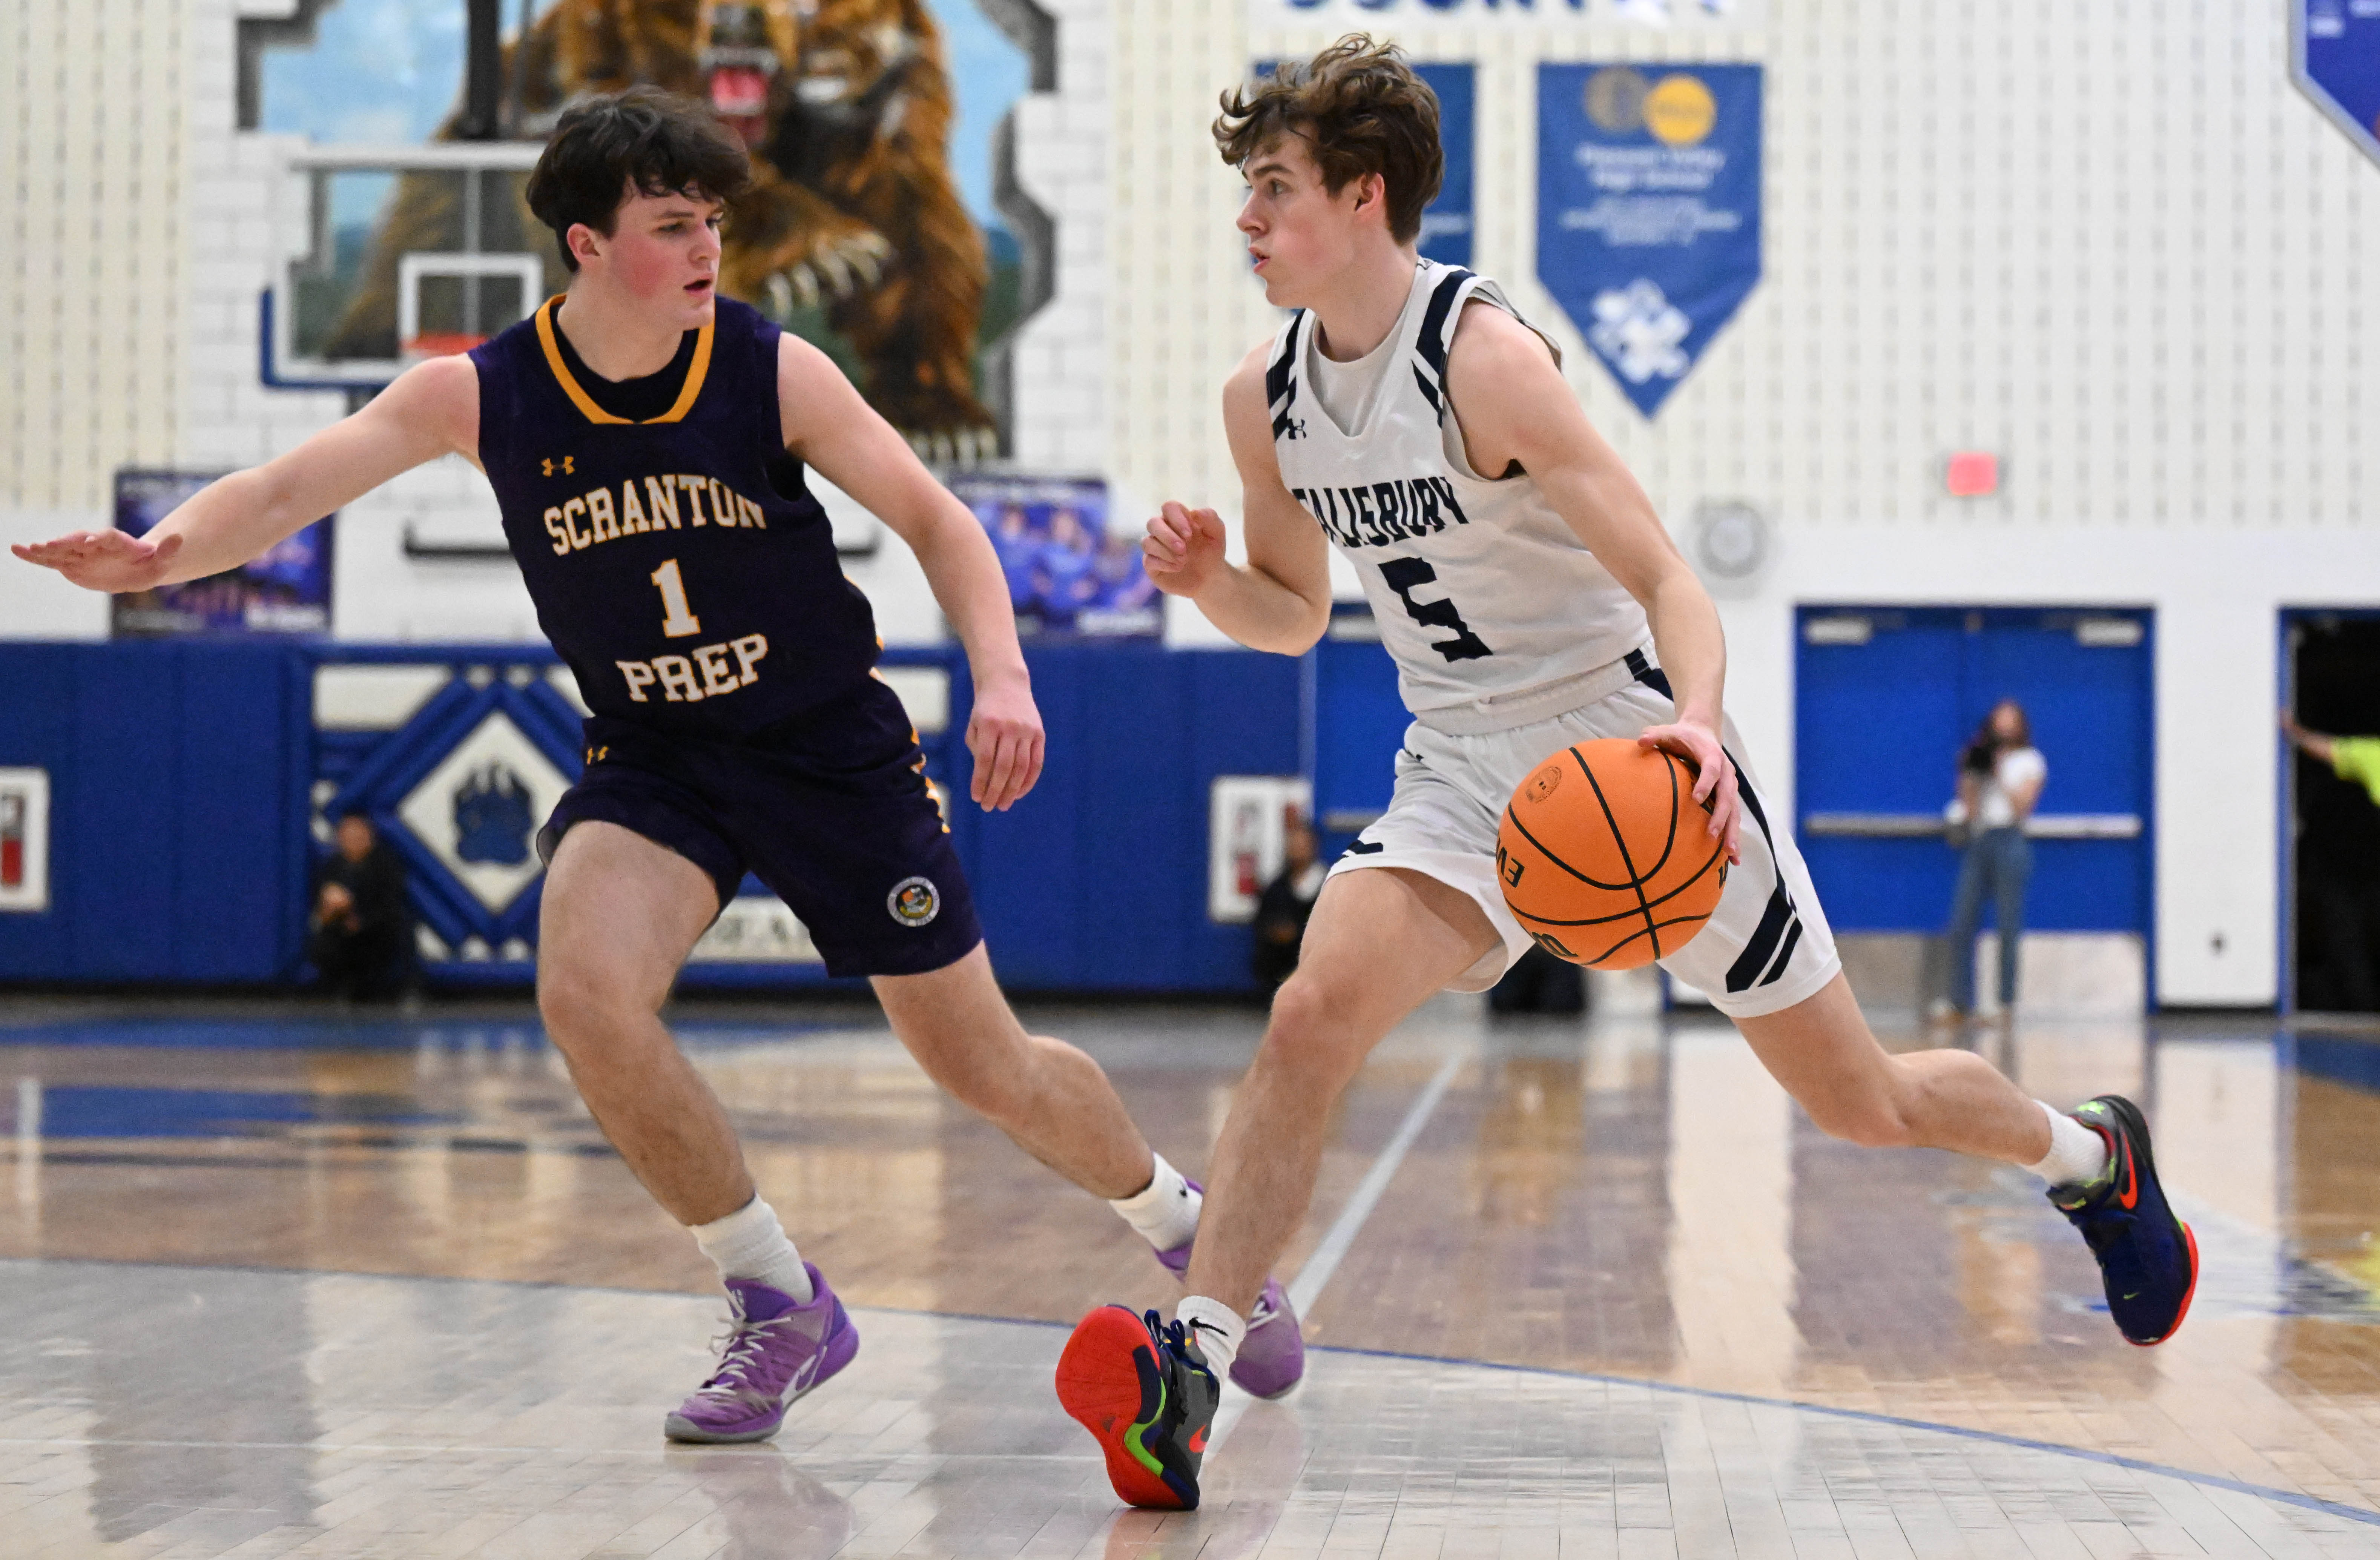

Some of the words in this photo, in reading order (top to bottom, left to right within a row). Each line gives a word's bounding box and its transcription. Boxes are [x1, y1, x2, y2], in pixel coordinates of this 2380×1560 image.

[543, 473, 766, 556] SCRANTON
[650, 558, 701, 638] 1
[1378, 556, 1493, 663] 5
[615, 633, 769, 702] PREP
